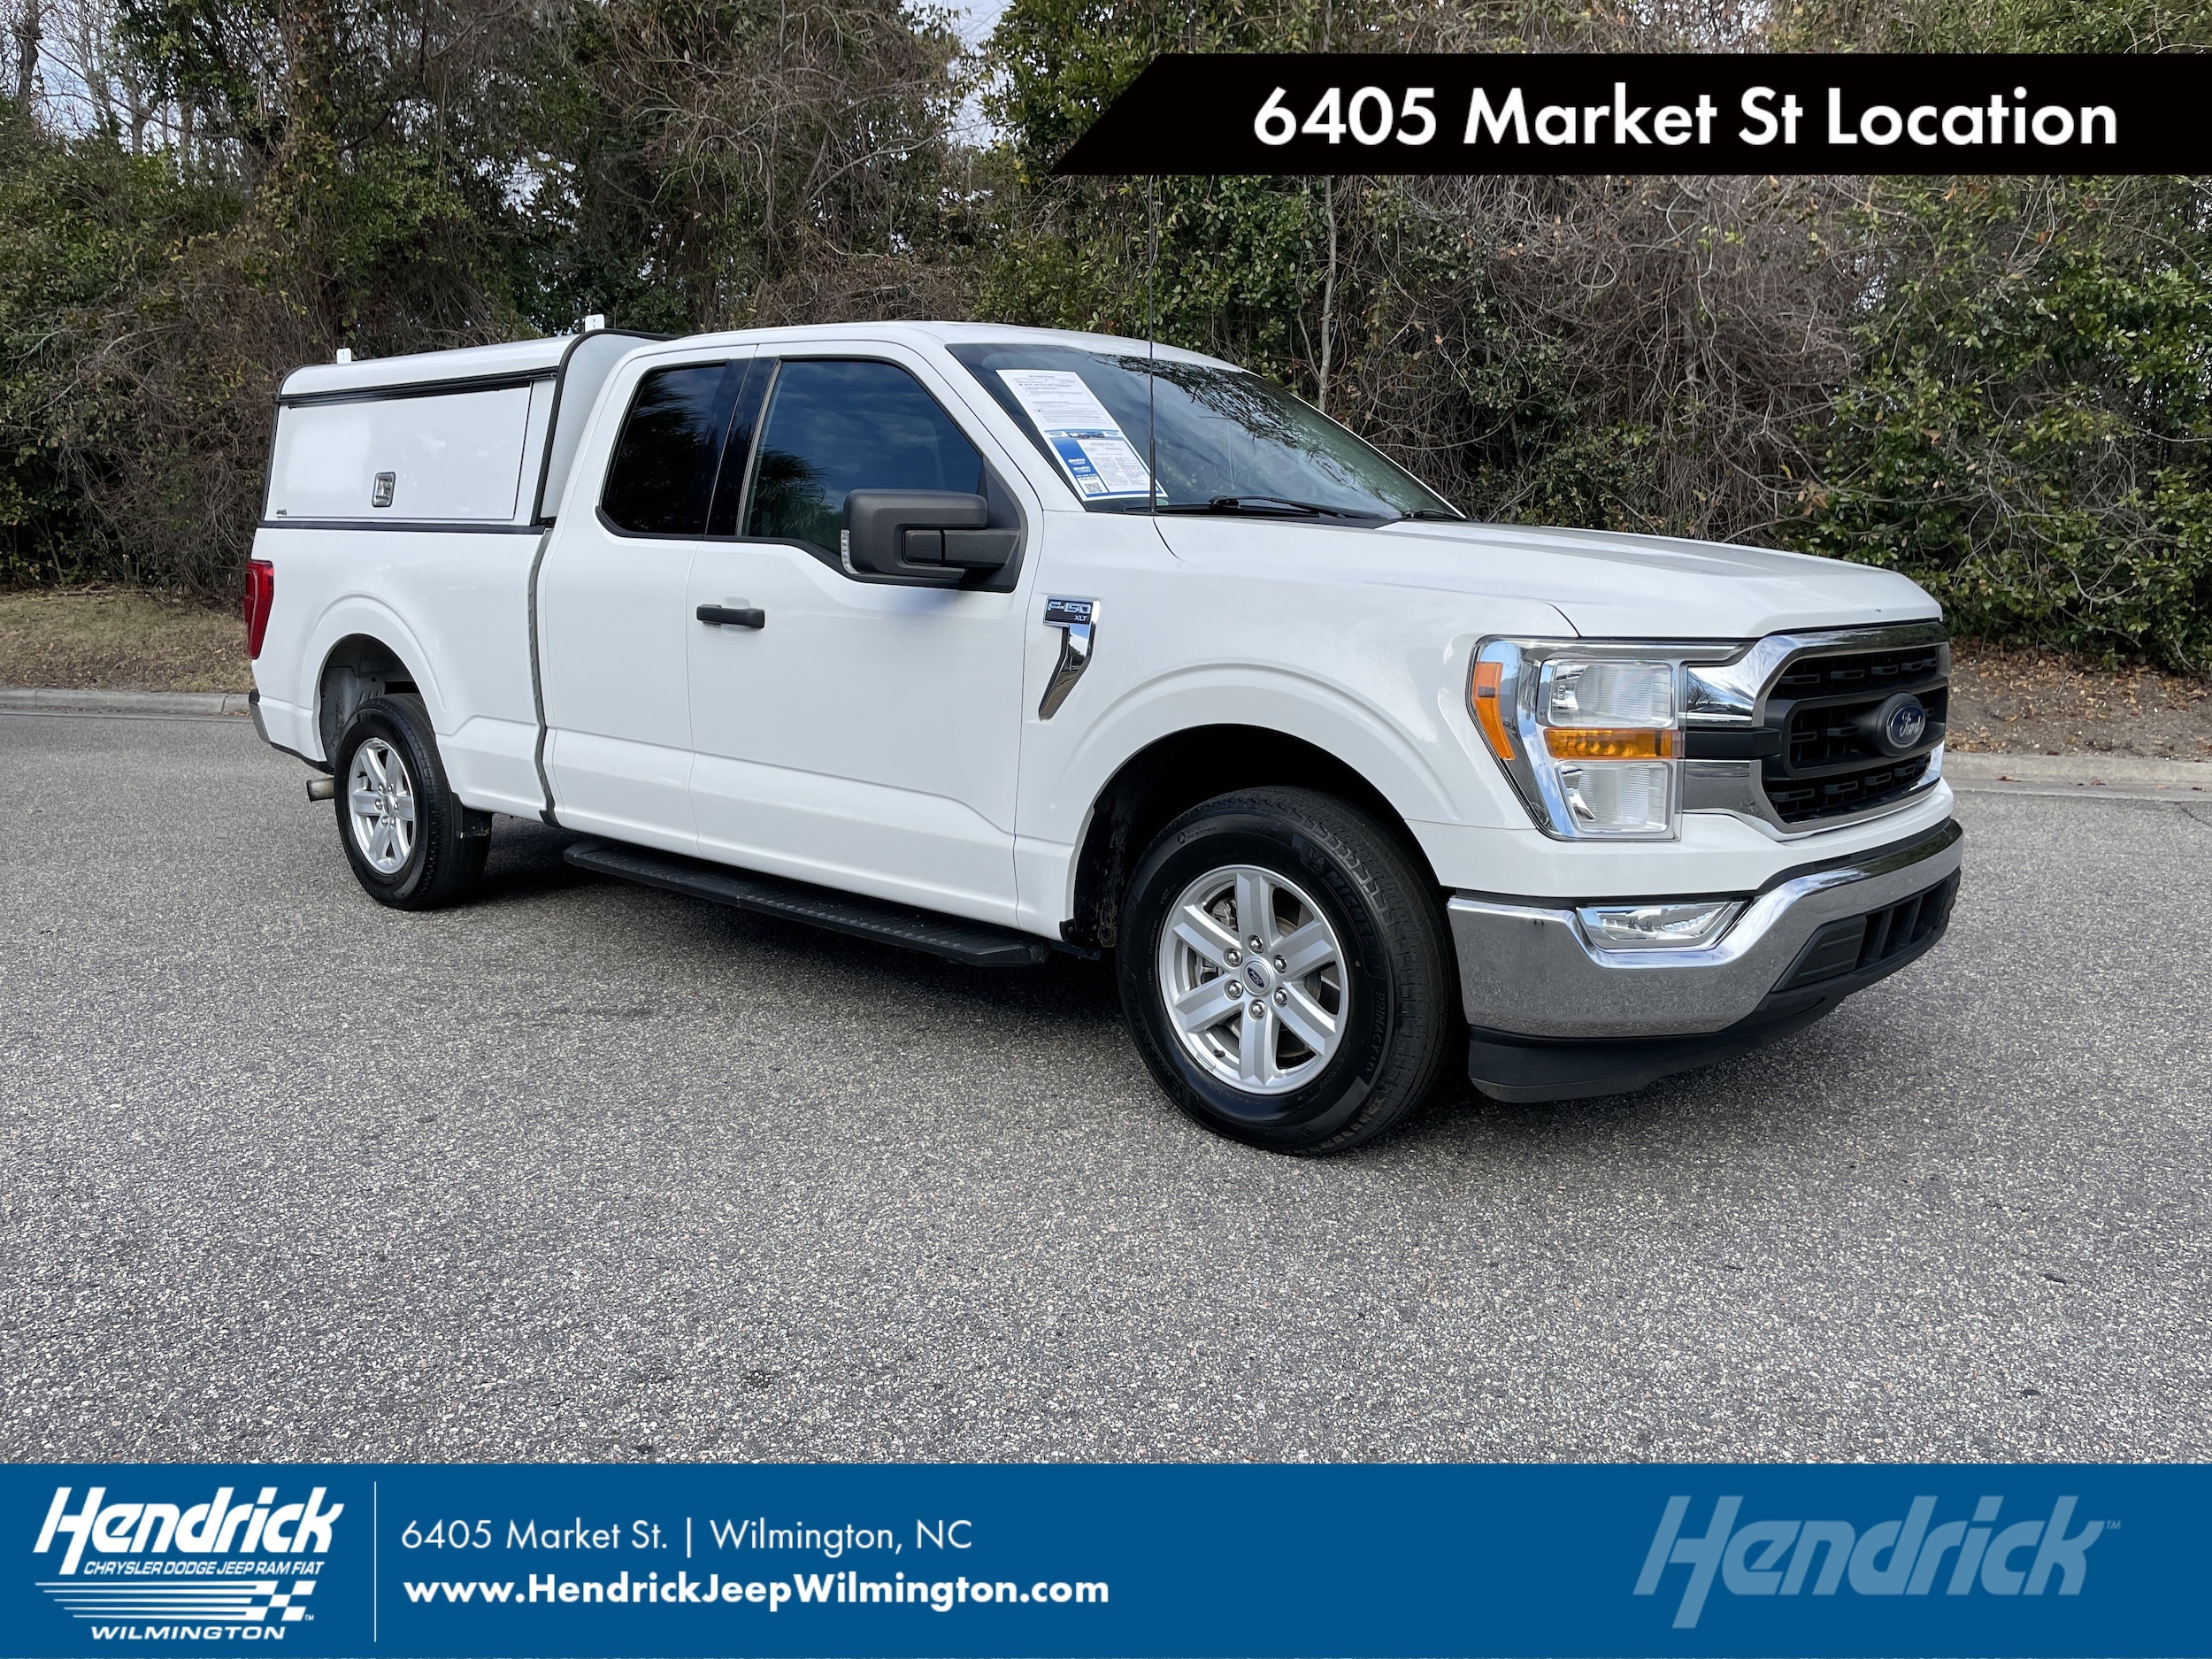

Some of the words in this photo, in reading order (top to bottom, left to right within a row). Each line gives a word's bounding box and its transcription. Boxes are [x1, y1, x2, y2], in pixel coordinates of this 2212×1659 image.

[1048, 601, 1092, 614] F-150
[1899, 711, 1922, 738] Ford
[1325, 870, 1382, 969] MICHELIN
[1371, 991, 1386, 1054] PRIMACY
